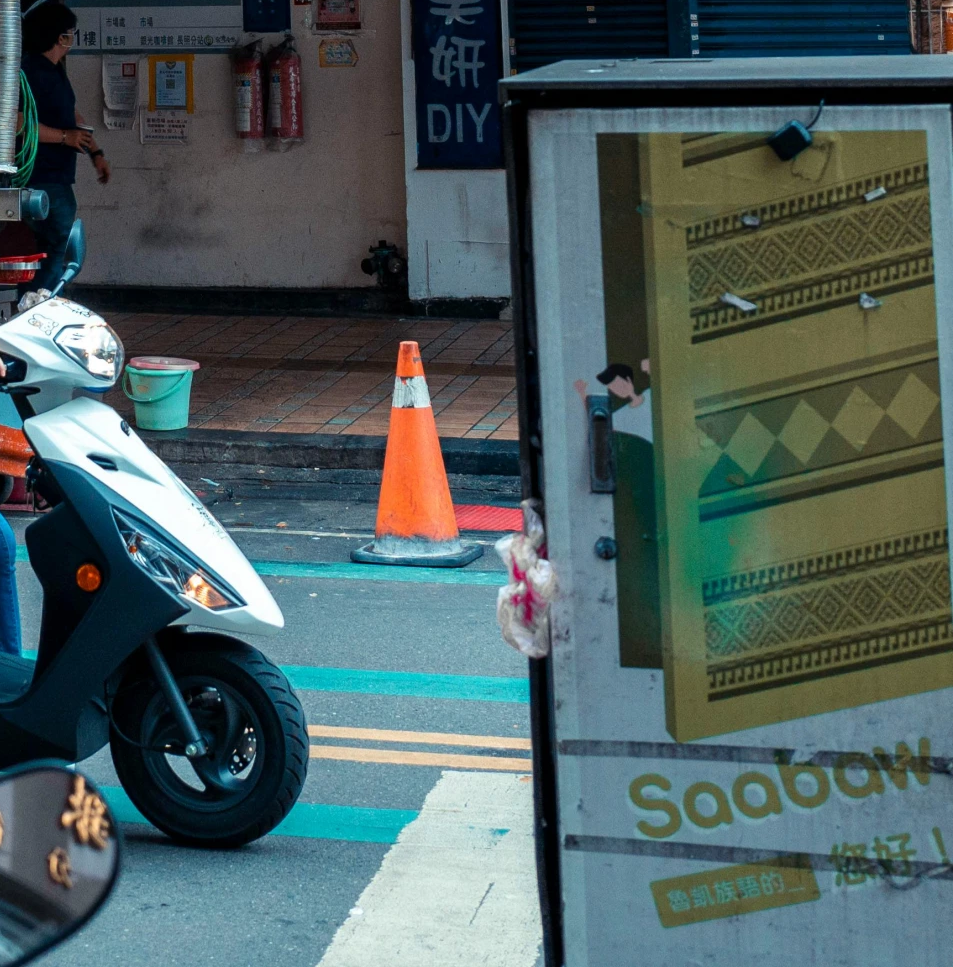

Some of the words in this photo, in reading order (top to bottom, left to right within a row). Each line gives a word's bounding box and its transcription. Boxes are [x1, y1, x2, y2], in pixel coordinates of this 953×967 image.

[73, 30, 97, 46] 1樓
[426, 103, 493, 143] DIY
[628, 736, 932, 839] Saabaw
